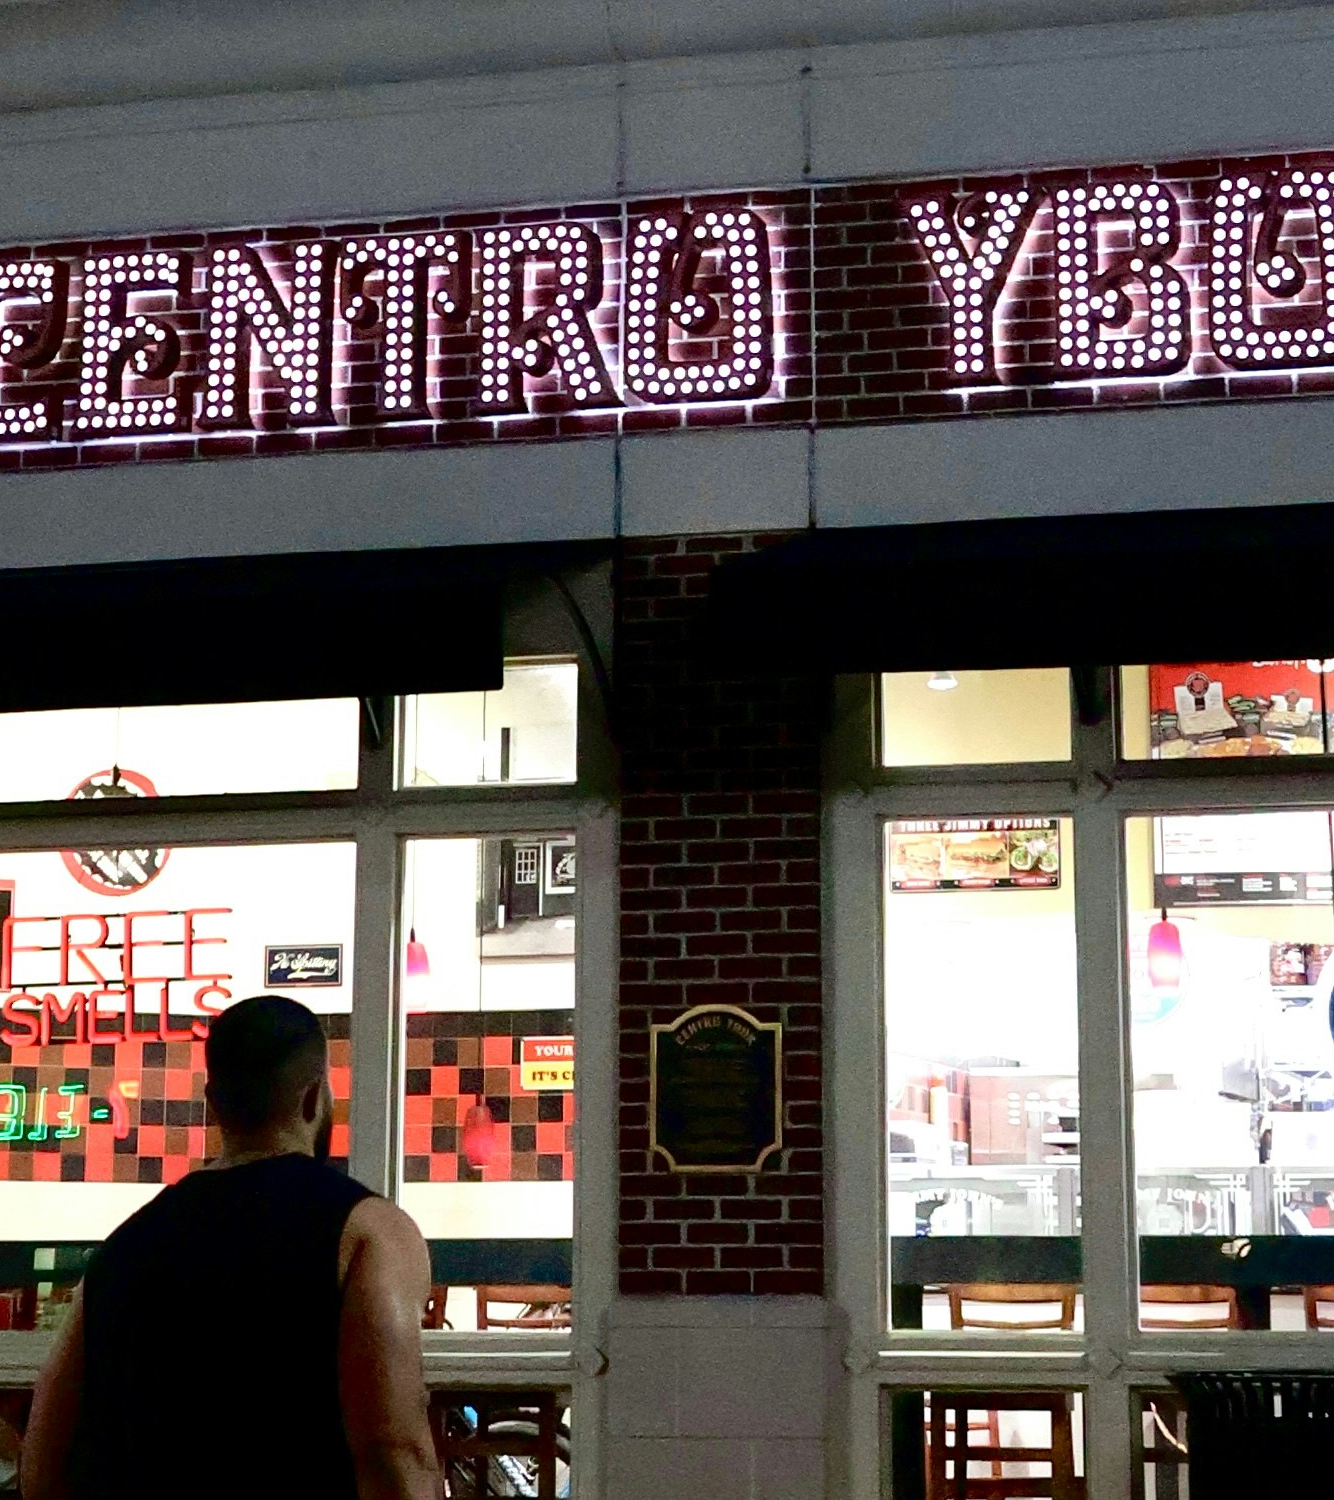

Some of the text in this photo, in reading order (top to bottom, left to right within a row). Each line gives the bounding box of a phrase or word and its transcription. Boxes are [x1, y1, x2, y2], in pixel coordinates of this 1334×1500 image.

[2, 908, 233, 990] FREE
[1, 985, 233, 1048] SMELLS
[534, 1045, 573, 1057] YOUR
[532, 1070, 558, 1082] IT'S
